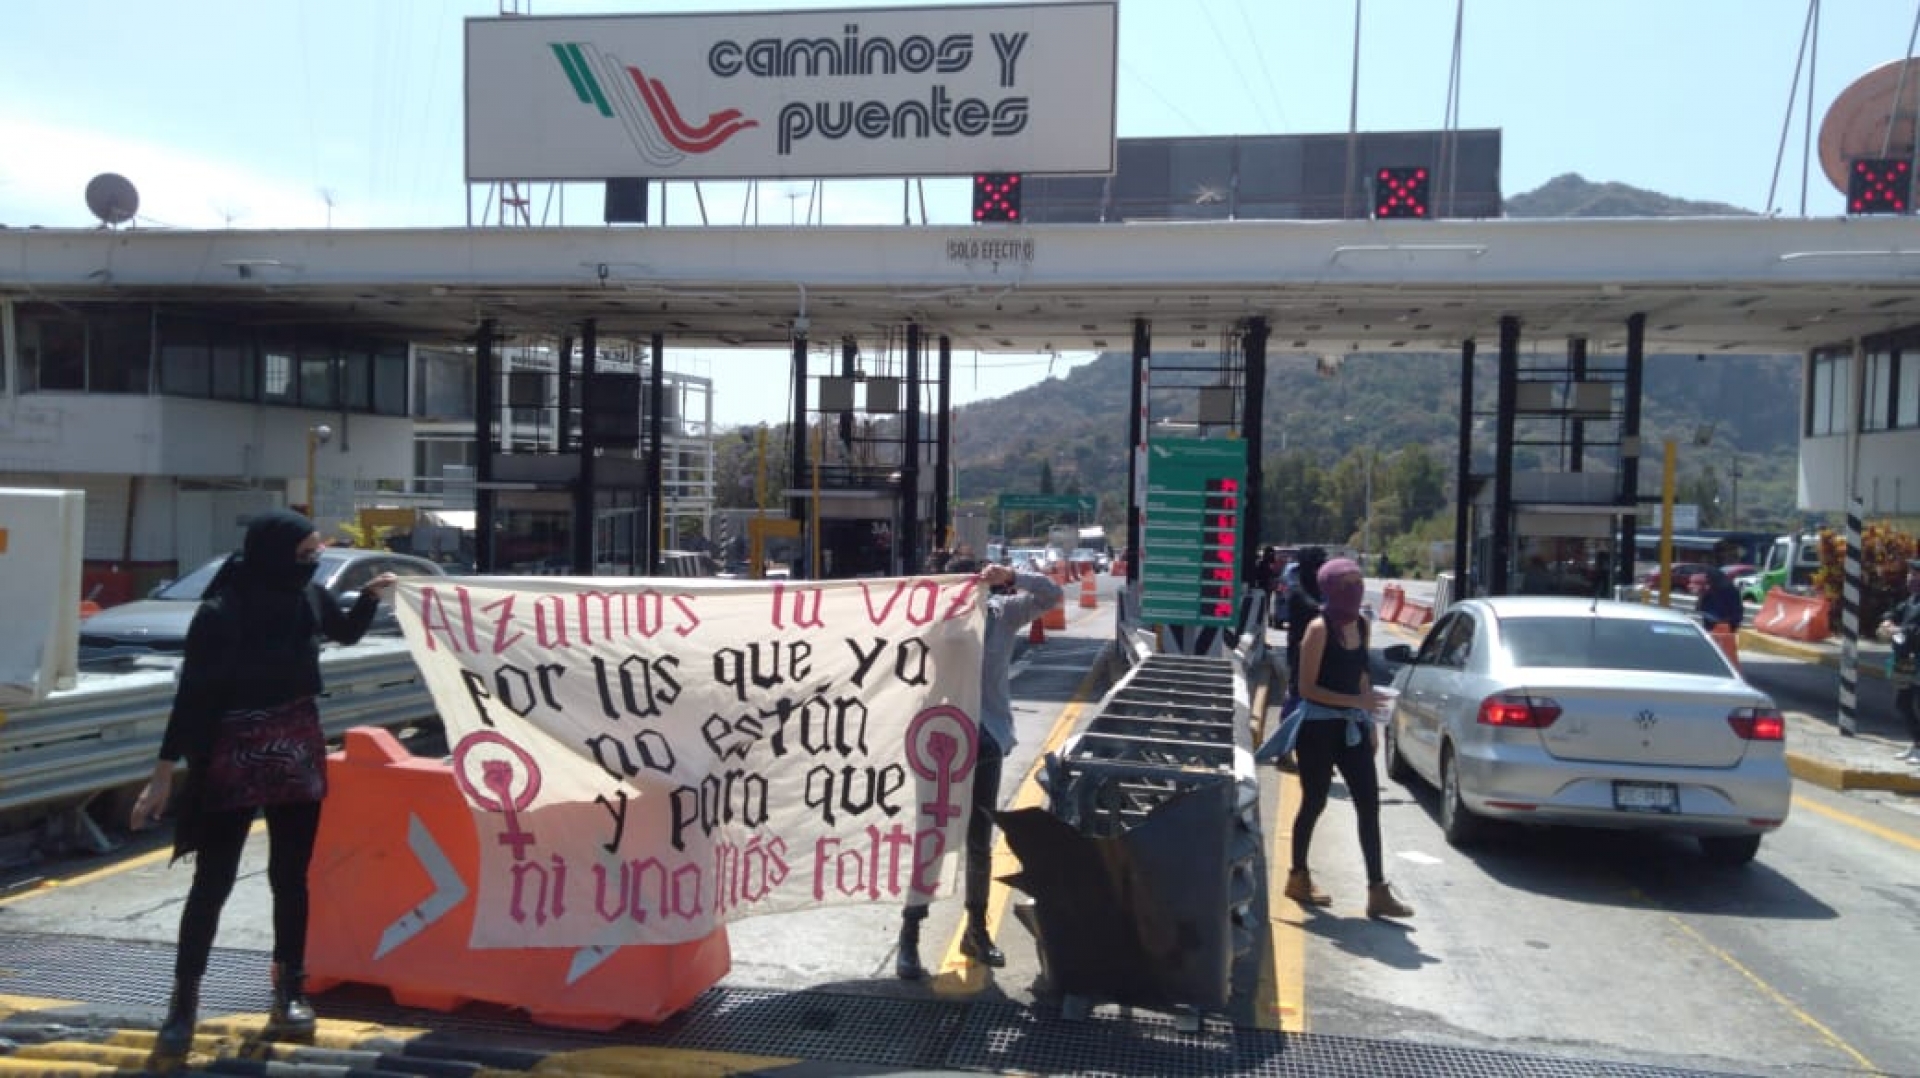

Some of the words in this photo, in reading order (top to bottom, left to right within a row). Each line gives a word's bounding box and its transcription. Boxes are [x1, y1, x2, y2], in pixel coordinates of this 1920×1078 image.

[709, 24, 973, 77] caminos
[990, 32, 1029, 88] Y
[777, 85, 1029, 155] puentes
[420, 587, 700, 654] Alzamos
[771, 584, 824, 629] la
[591, 654, 682, 719] las
[713, 639, 811, 701] que
[585, 729, 676, 780] no
[702, 682, 868, 761] están
[595, 790, 627, 853] y
[669, 768, 769, 851] para
[805, 763, 905, 826] que
[510, 853, 566, 926] ni
[591, 856, 703, 923] una
[714, 834, 790, 916] más
